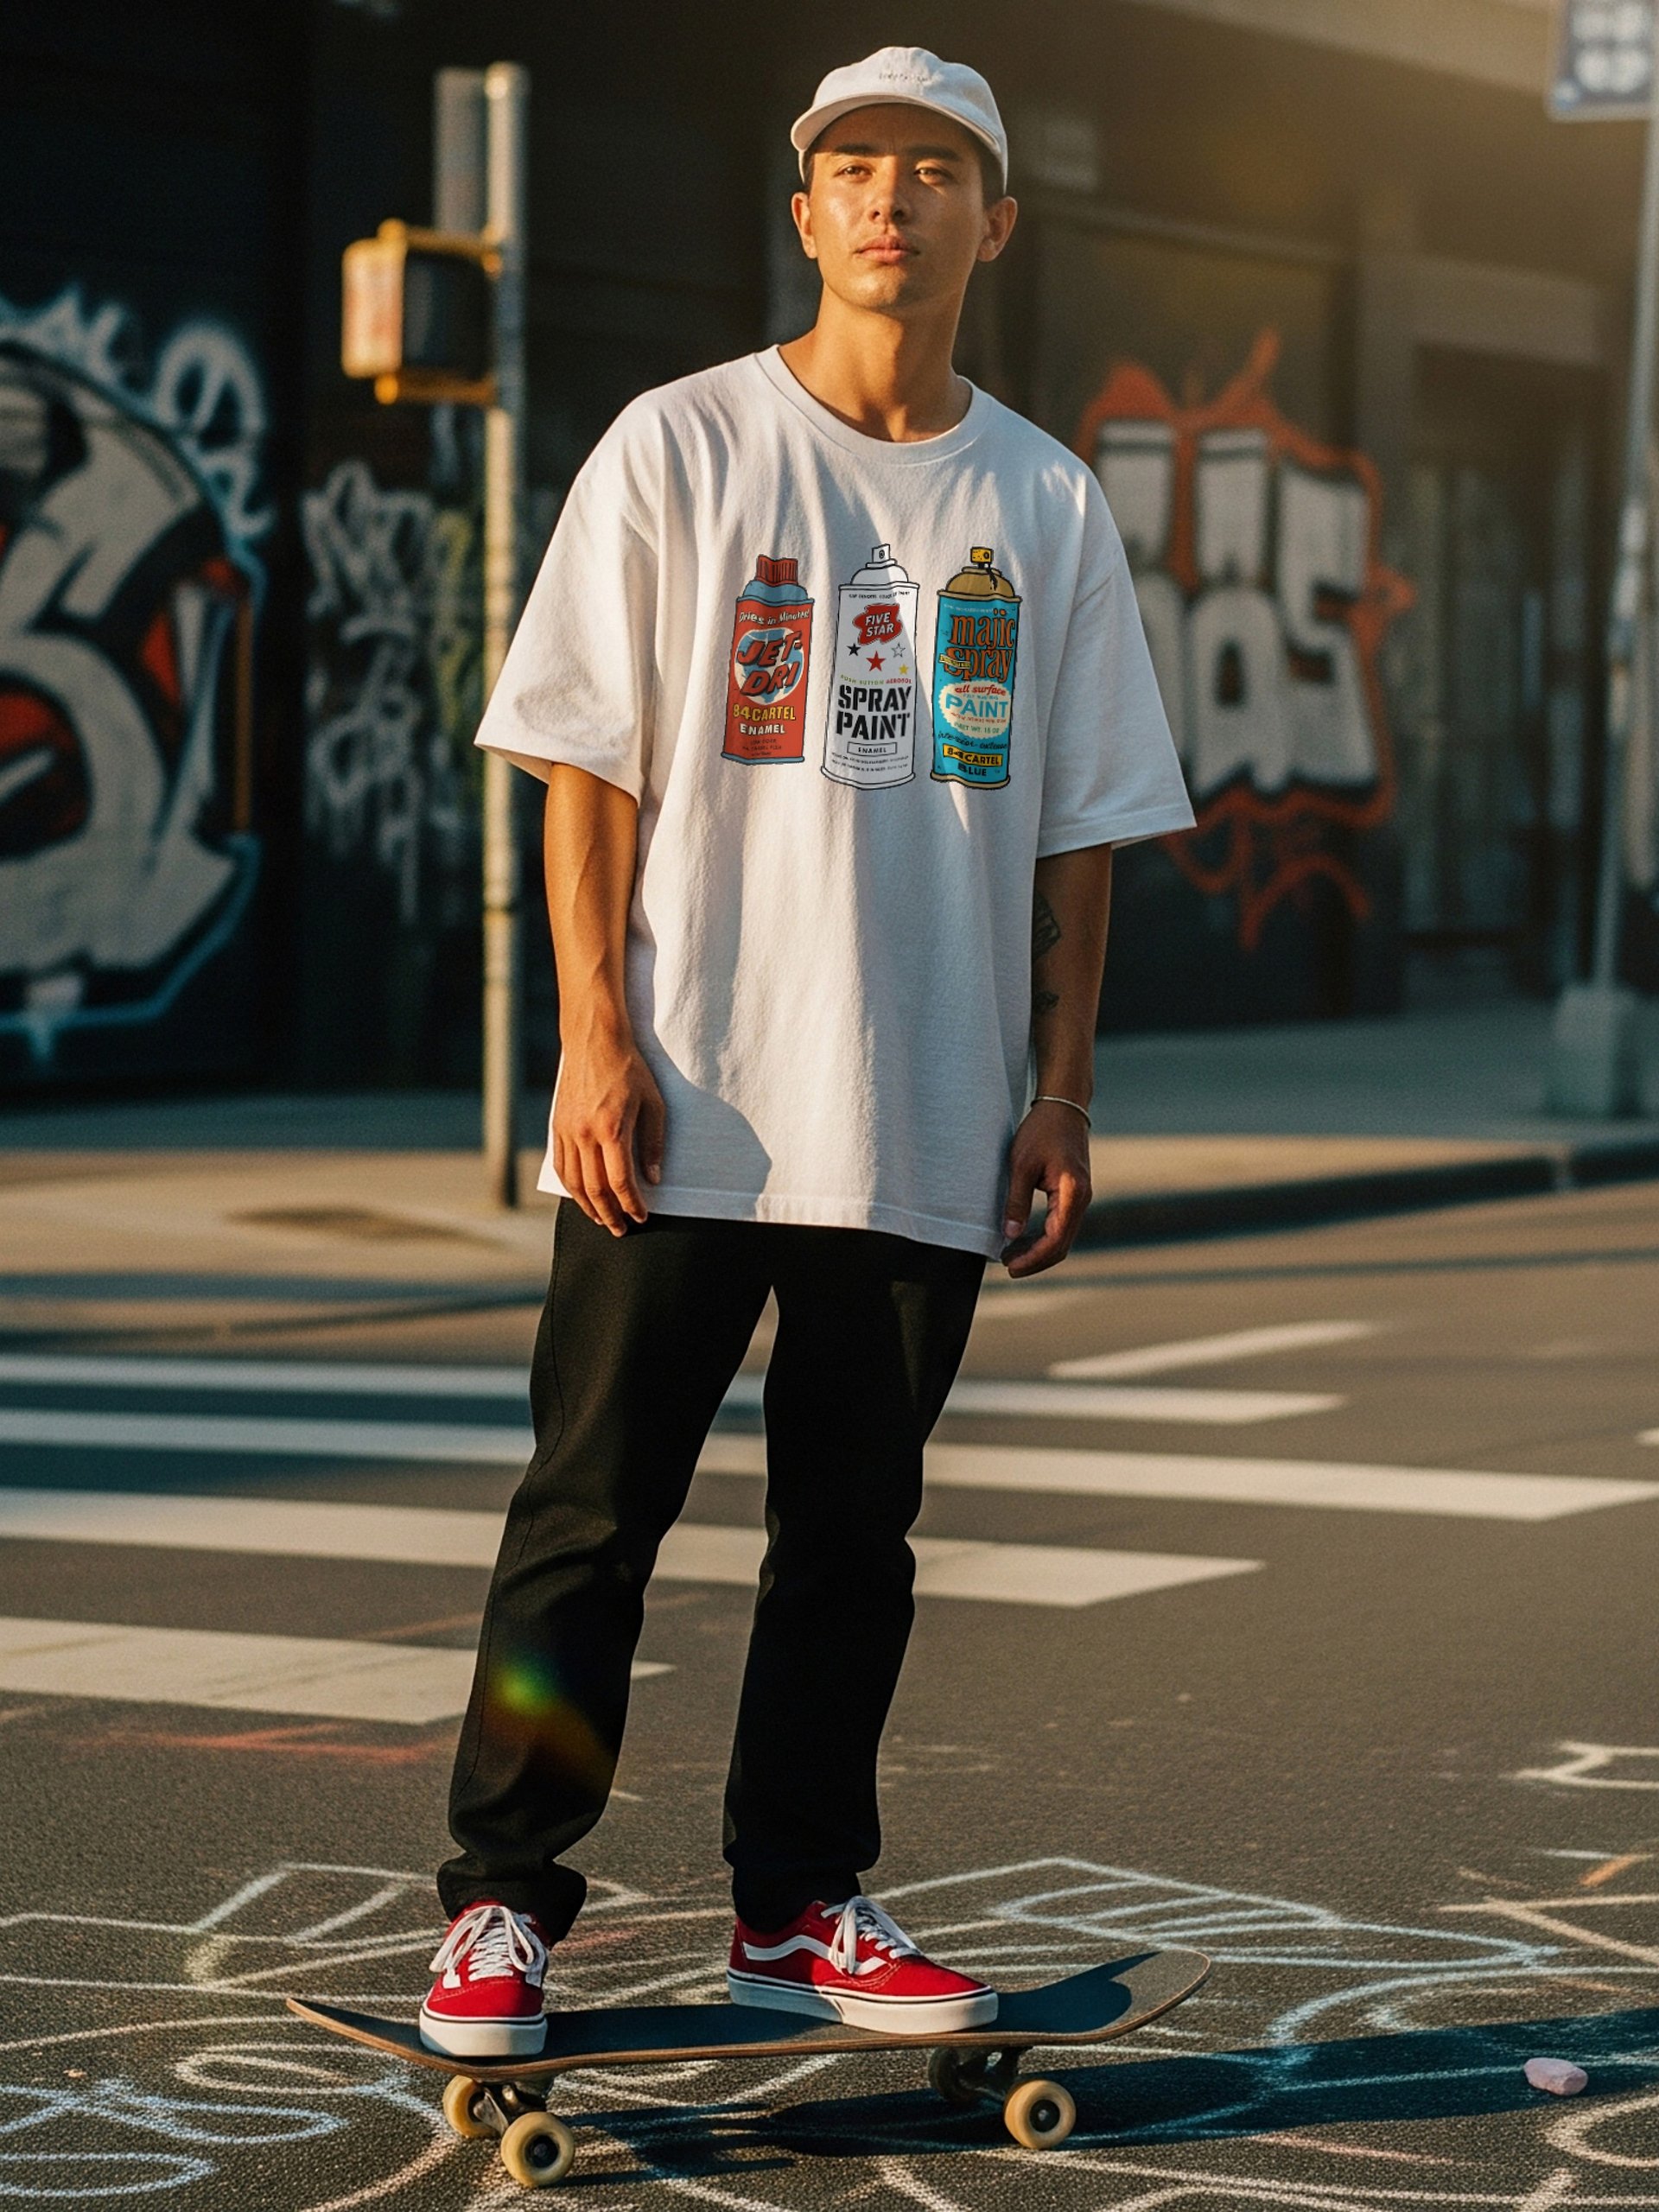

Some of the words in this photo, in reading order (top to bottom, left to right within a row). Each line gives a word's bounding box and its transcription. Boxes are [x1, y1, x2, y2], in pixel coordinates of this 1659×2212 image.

[739, 612, 765, 625] Dries
[767, 616, 777, 626] in
[865, 612, 891, 626] FIVE
[866, 623, 894, 637] STAR
[948, 607, 1016, 650] majic
[740, 660, 800, 696] DRI
[954, 684, 970, 693] all
[972, 684, 1007, 696] surface
[838, 684, 912, 712] SPRAY
[945, 692, 1009, 718] PAINT
[739, 722, 785, 736] ENAMEL
[836, 710, 911, 741] PAINT
[958, 762, 988, 777] BLUE
